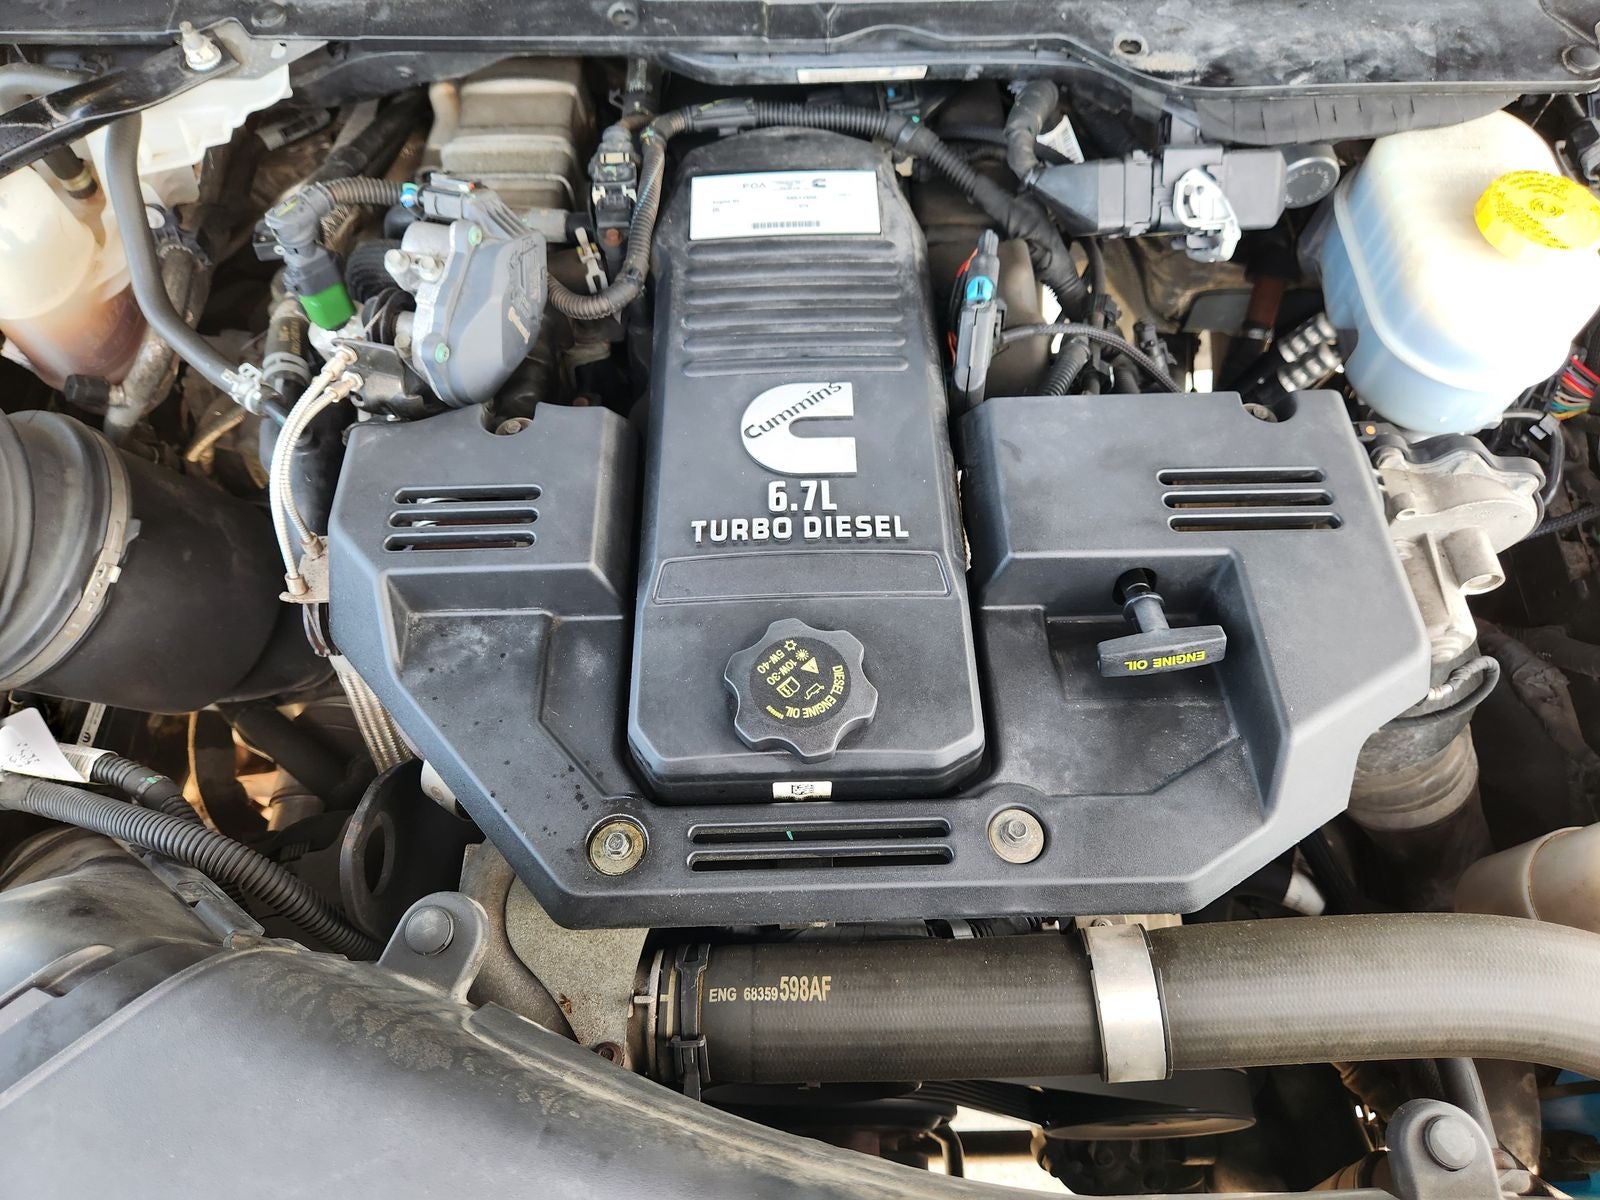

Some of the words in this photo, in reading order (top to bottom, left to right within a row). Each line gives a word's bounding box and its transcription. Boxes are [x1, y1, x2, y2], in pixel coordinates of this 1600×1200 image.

[743, 382, 843, 439] Cummins
[768, 480, 838, 513] 6.7L
[691, 516, 793, 544] TURBO
[803, 515, 910, 539] DIESEL
[756, 649, 786, 674] 5W-40
[1123, 659, 1149, 671] OIL
[1152, 650, 1207, 668] ENGINE
[766, 659, 797, 686] 10W-30
[829, 664, 846, 695] DIESEL
[785, 705, 801, 719] OIL
[802, 694, 837, 719] ENGINE
[708, 987, 737, 1003] ENG
